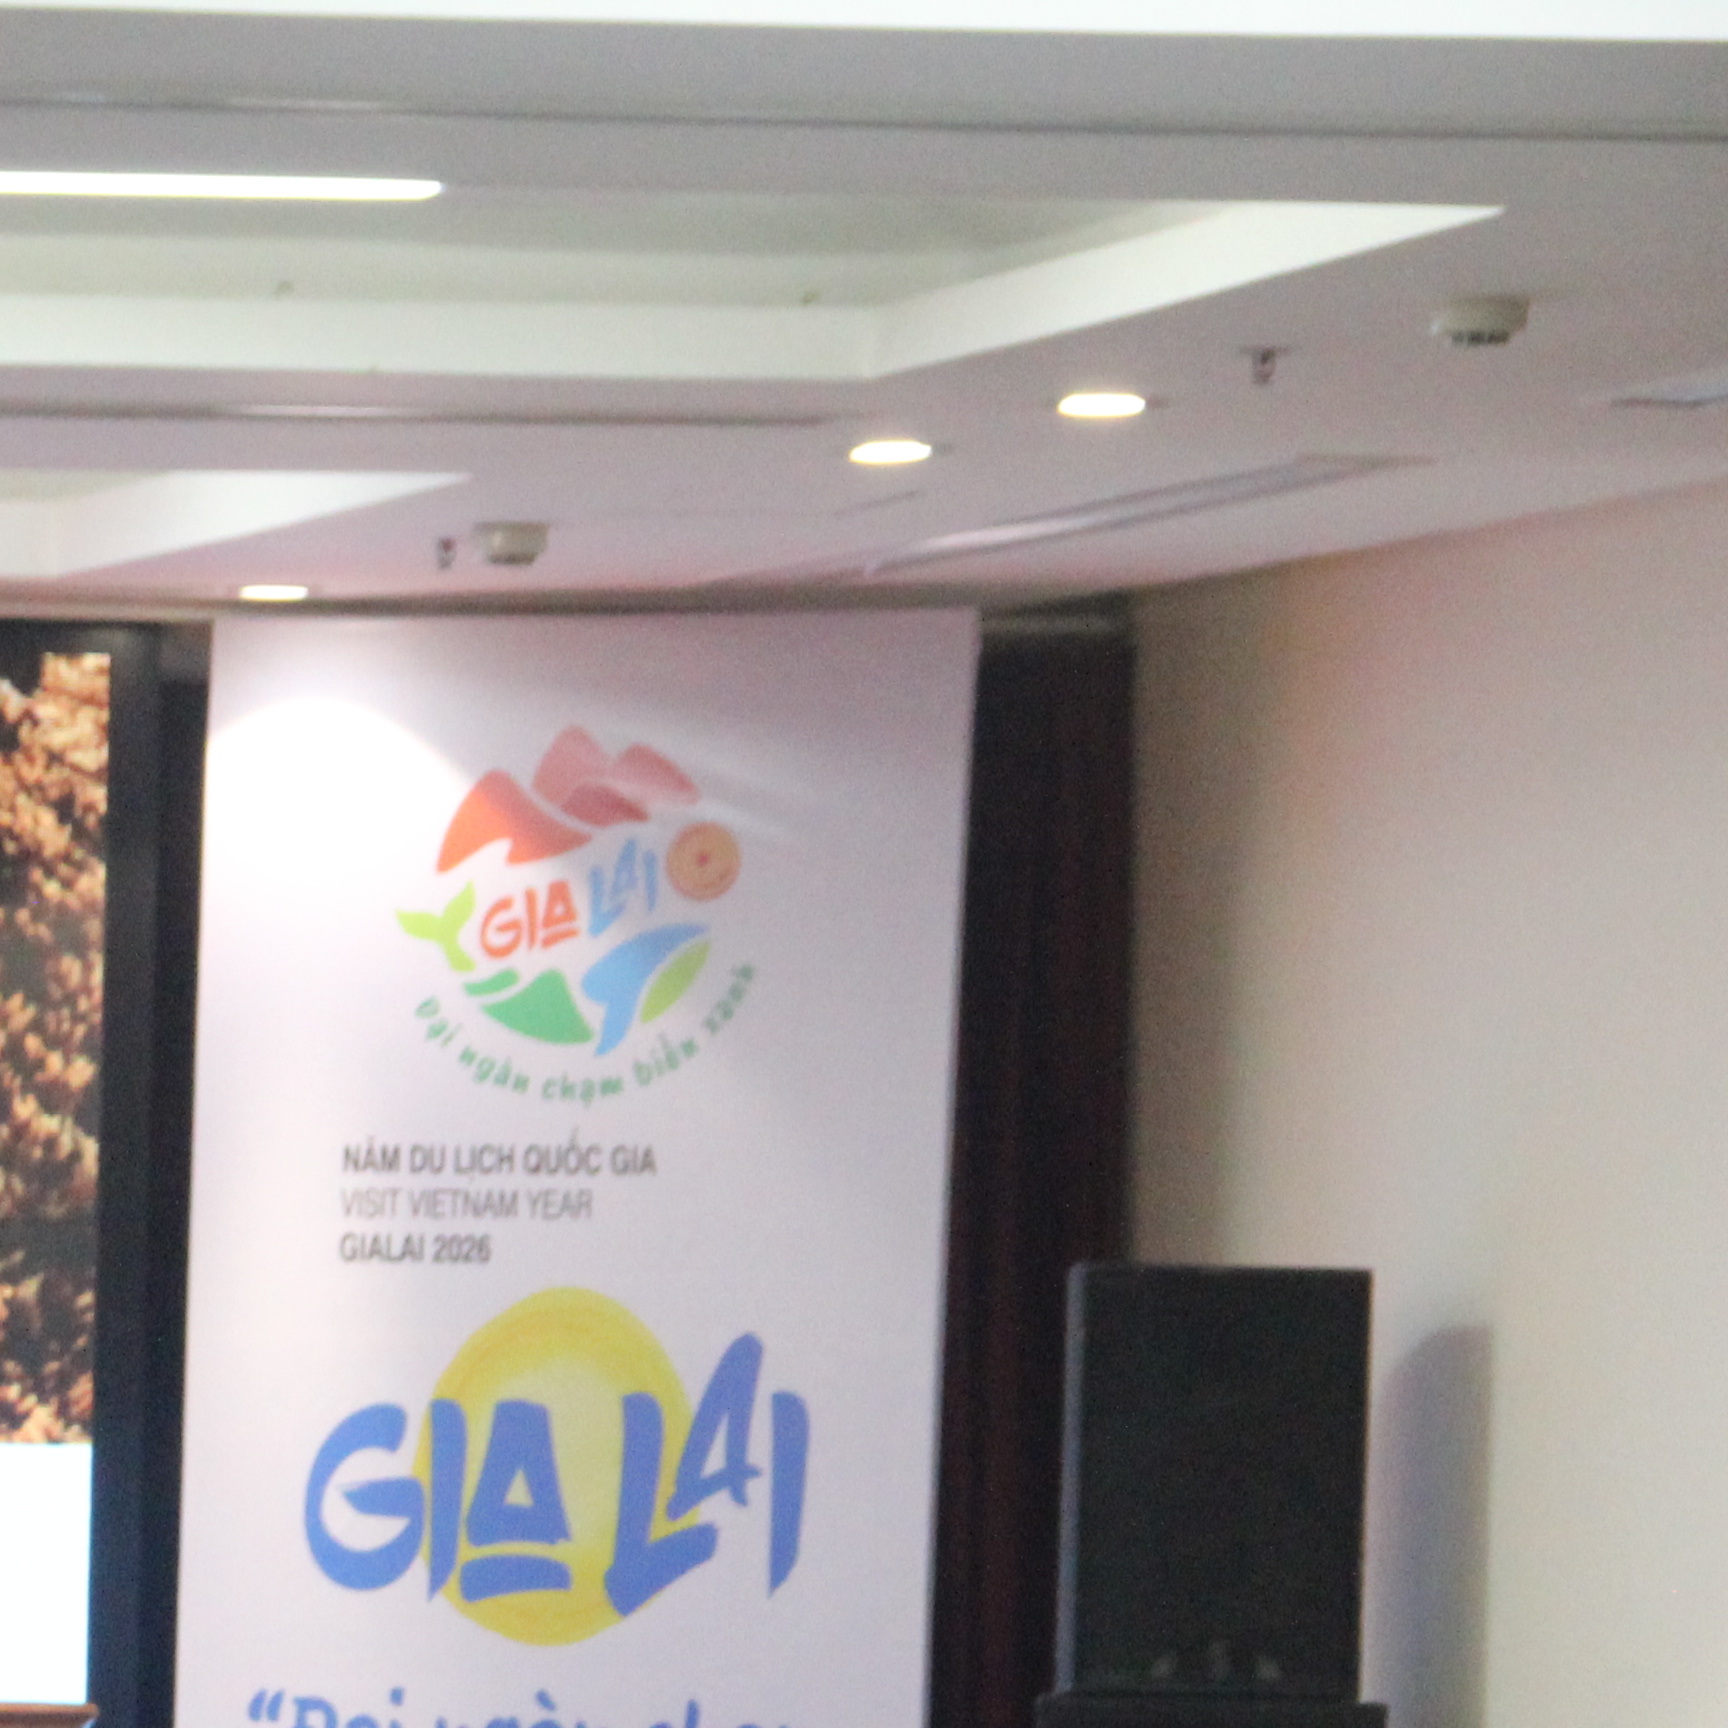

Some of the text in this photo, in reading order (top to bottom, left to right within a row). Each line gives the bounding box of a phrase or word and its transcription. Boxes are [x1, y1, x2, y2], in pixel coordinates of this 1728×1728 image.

[481, 838, 659, 959] GIA LAI
[409, 1144, 446, 1175] DU
[454, 1144, 516, 1181] LỊCH
[523, 1127, 602, 1176] QUỐC
[611, 1146, 657, 1175] GIA
[342, 1187, 593, 1220] VISIT VIETNAM YEAR
[433, 1234, 492, 1264] 2026
[305, 1334, 809, 1617] GIA LAI
